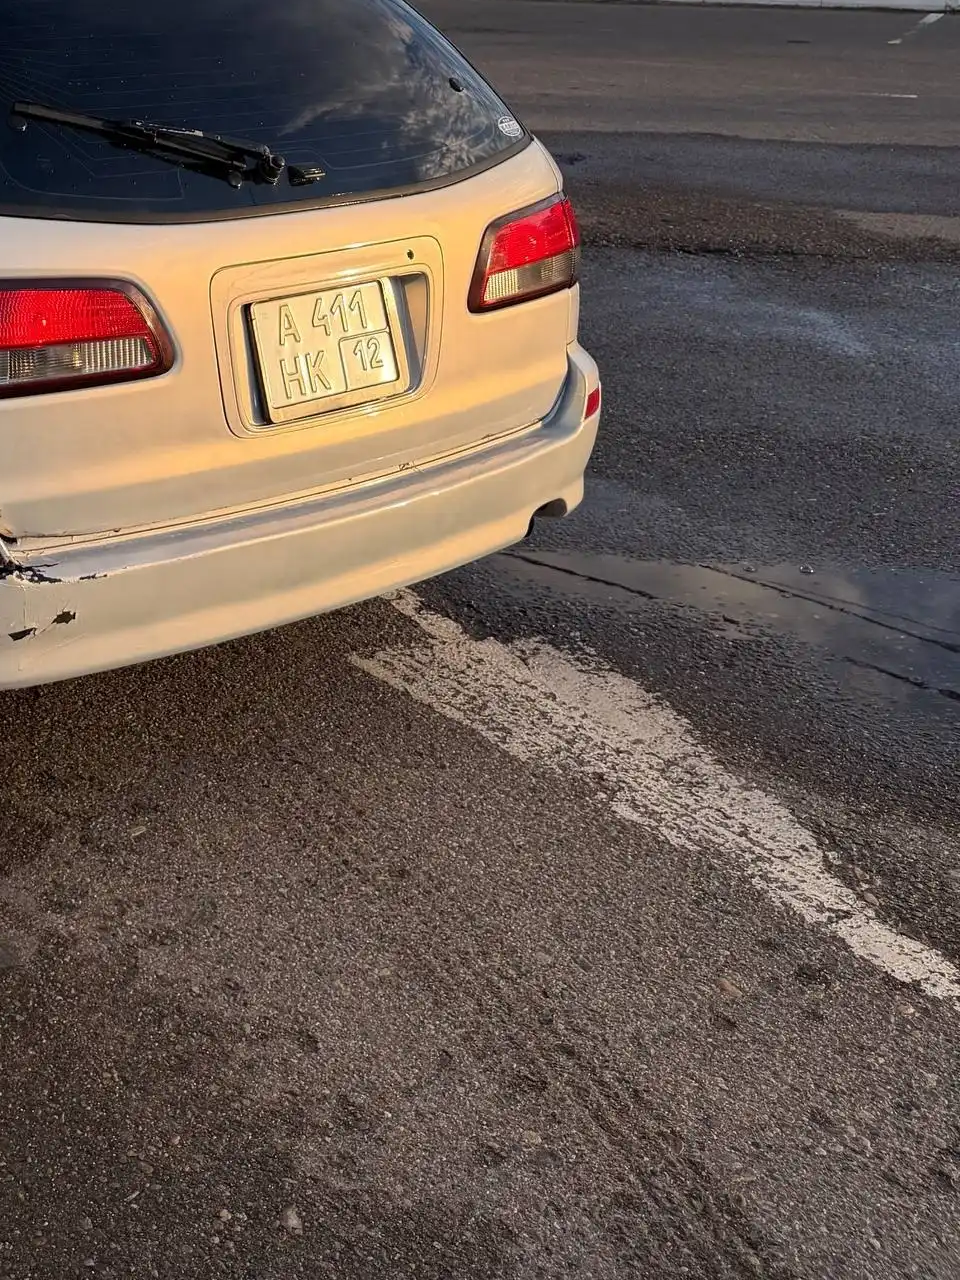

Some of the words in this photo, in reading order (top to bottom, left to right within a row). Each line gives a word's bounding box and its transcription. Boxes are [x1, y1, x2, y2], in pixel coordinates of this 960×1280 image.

[278, 304, 301, 346] А
[311, 289, 368, 337] 411
[279, 349, 332, 400] НК
[352, 336, 385, 372] 12
